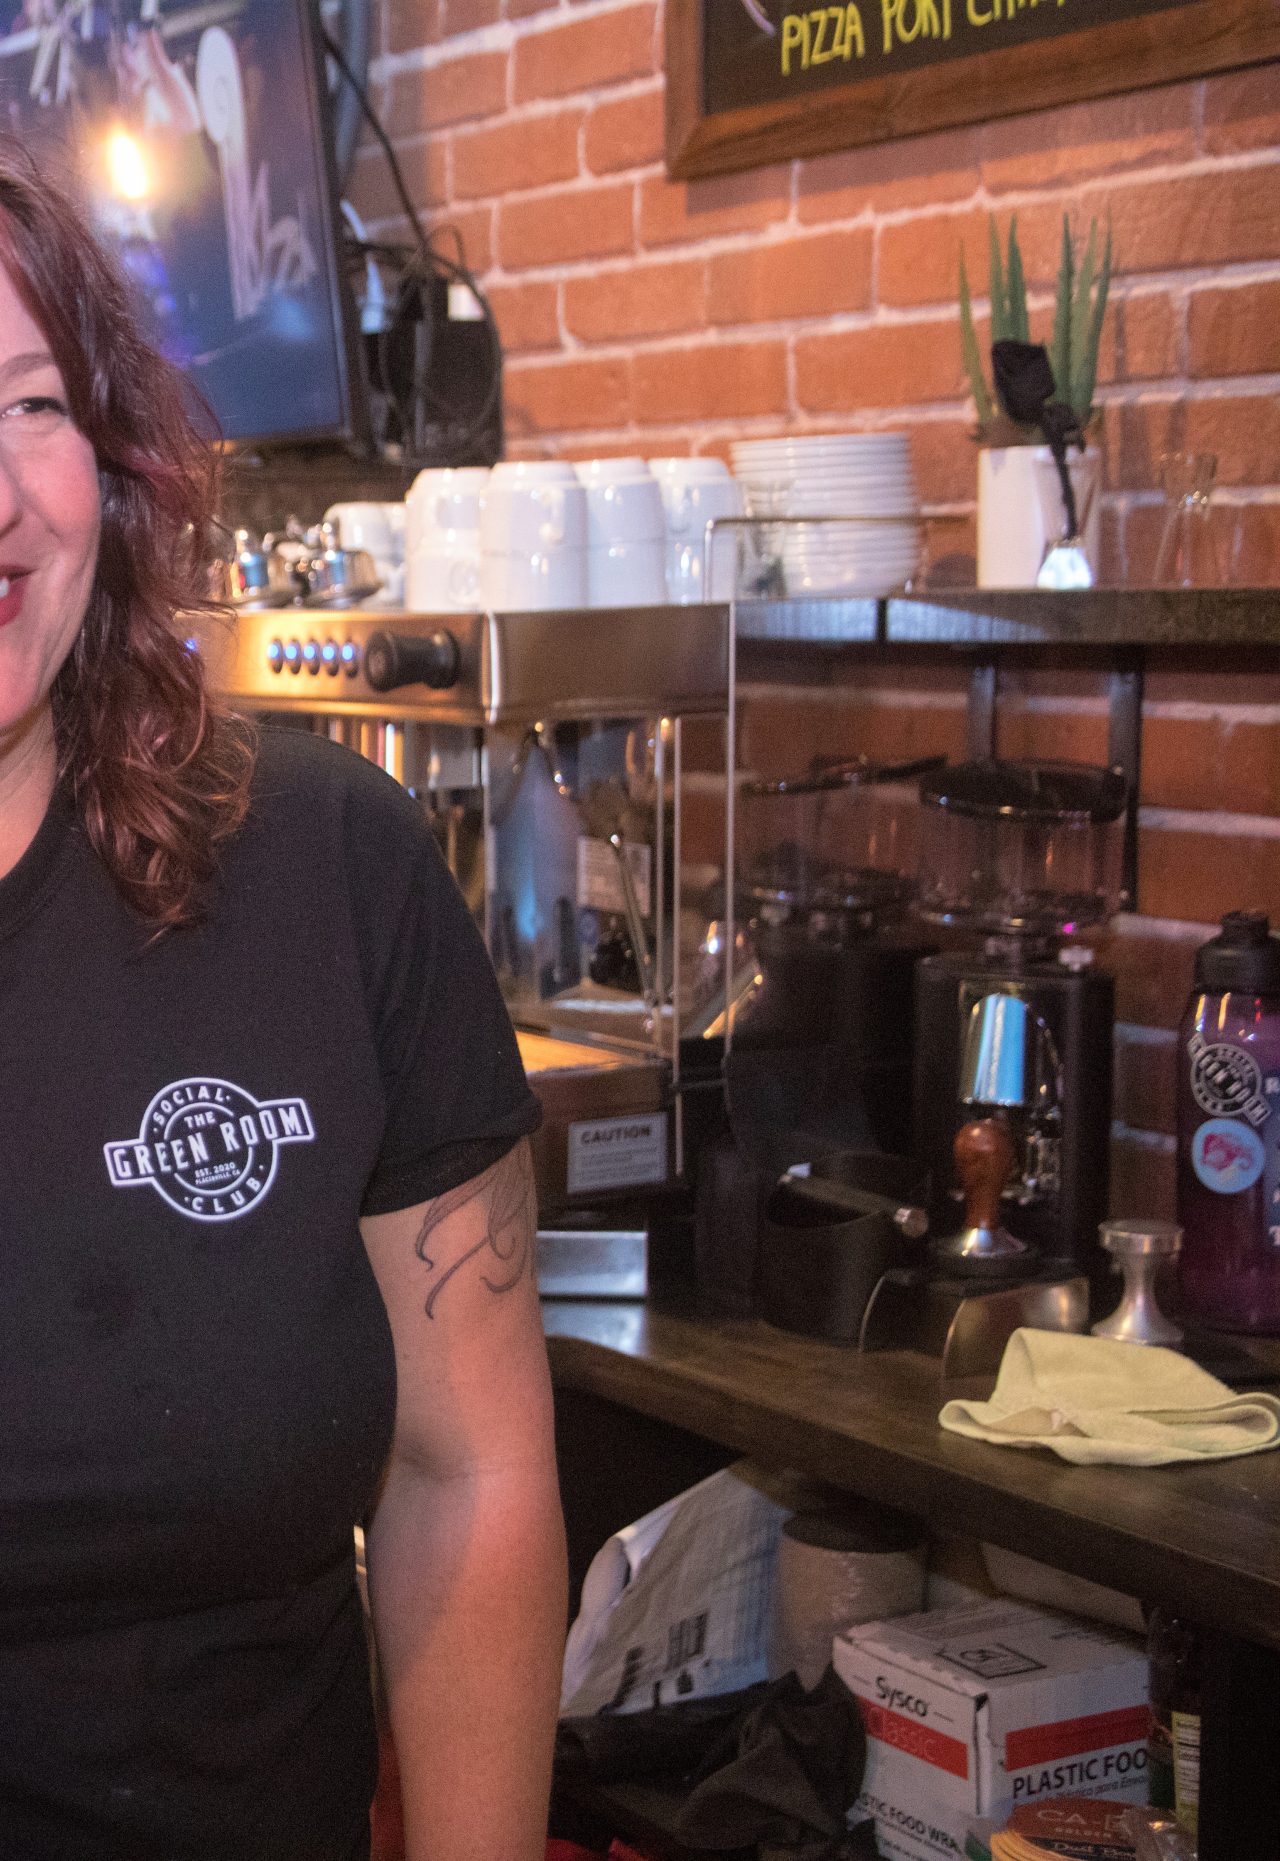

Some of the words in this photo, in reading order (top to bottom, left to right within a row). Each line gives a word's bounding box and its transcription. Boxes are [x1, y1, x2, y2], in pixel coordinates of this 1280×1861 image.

[781, 2, 865, 76] PIZZA
[152, 1085, 224, 1126] SOCIAL
[184, 1111, 216, 1129] THE
[112, 1132, 210, 1178] GREEN
[220, 1106, 304, 1152] ROOM
[581, 1126, 652, 1144] CAUTION
[213, 1162, 236, 1174] 2020
[191, 1177, 261, 1214] CLUB
[876, 1675, 929, 1717] Sysco
[1012, 1757, 1098, 1799] PLASTIC
[888, 1806, 926, 1835] FOOD
